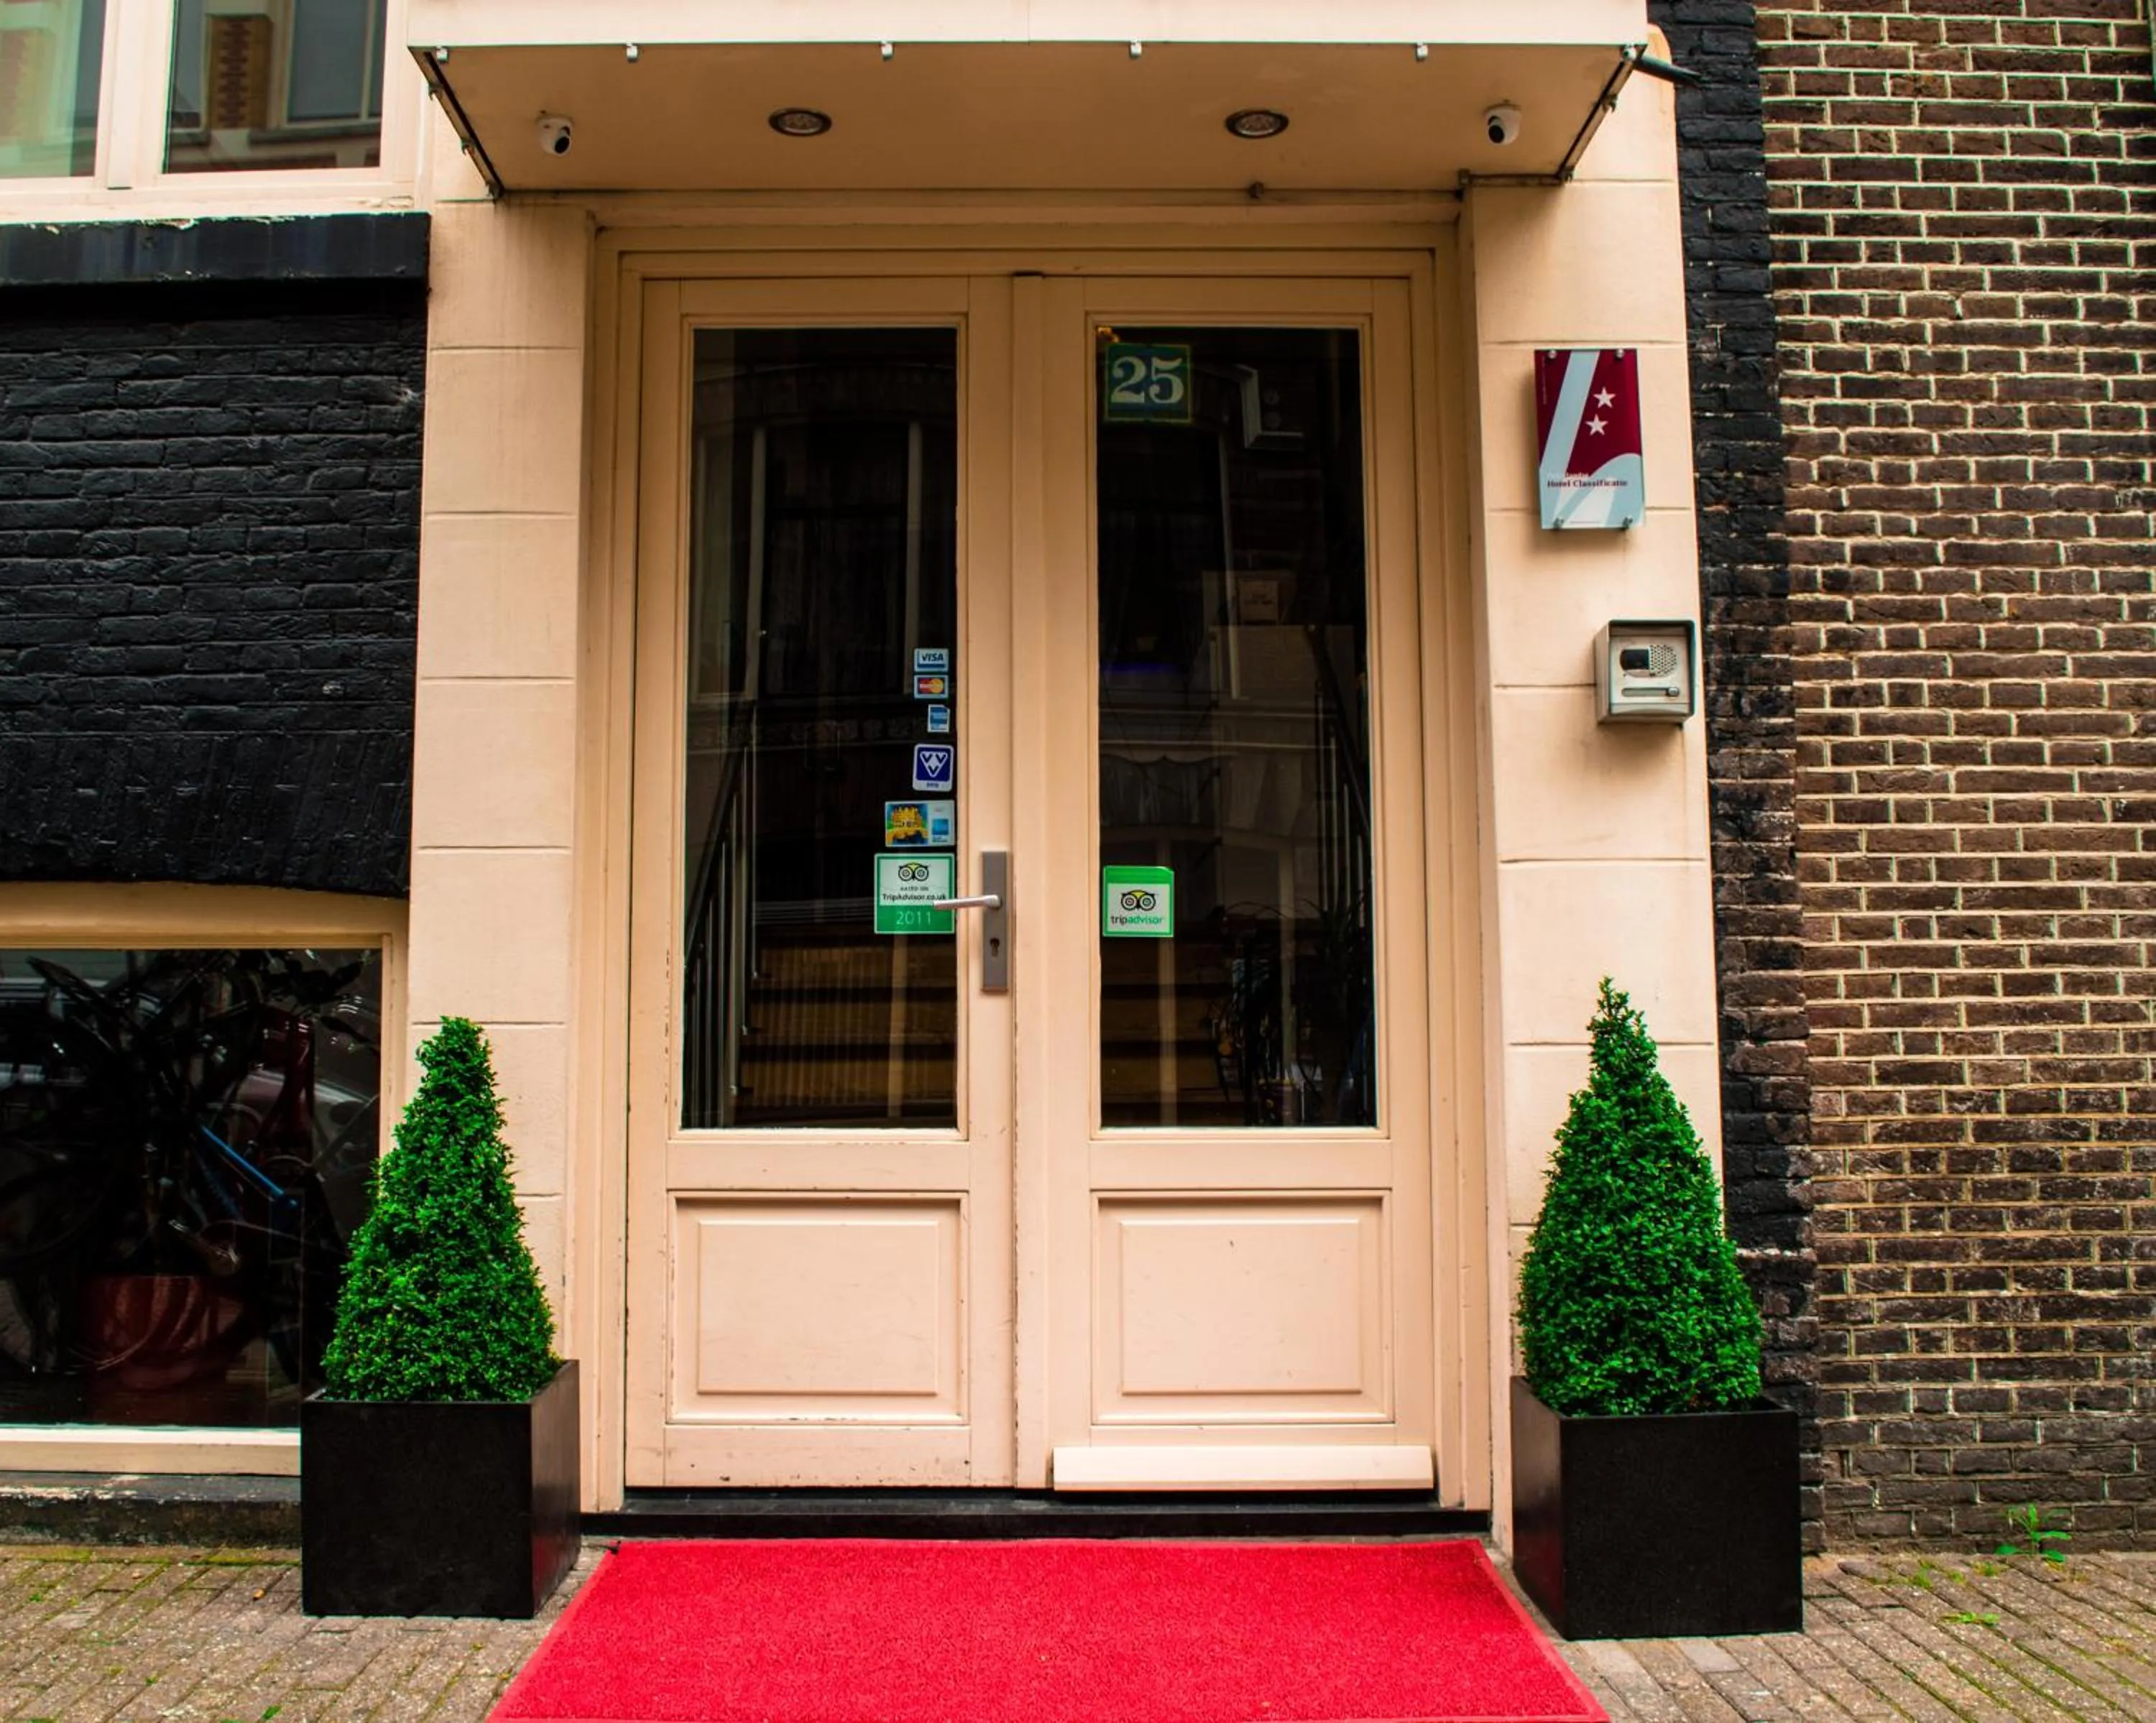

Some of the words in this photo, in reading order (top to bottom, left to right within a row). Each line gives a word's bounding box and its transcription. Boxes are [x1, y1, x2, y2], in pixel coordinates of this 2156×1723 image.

[1111, 356, 1184, 404] 25
[921, 653, 944, 662] VISA
[896, 910, 931, 925] 2011
[1110, 914, 1163, 925] tripadvisor
